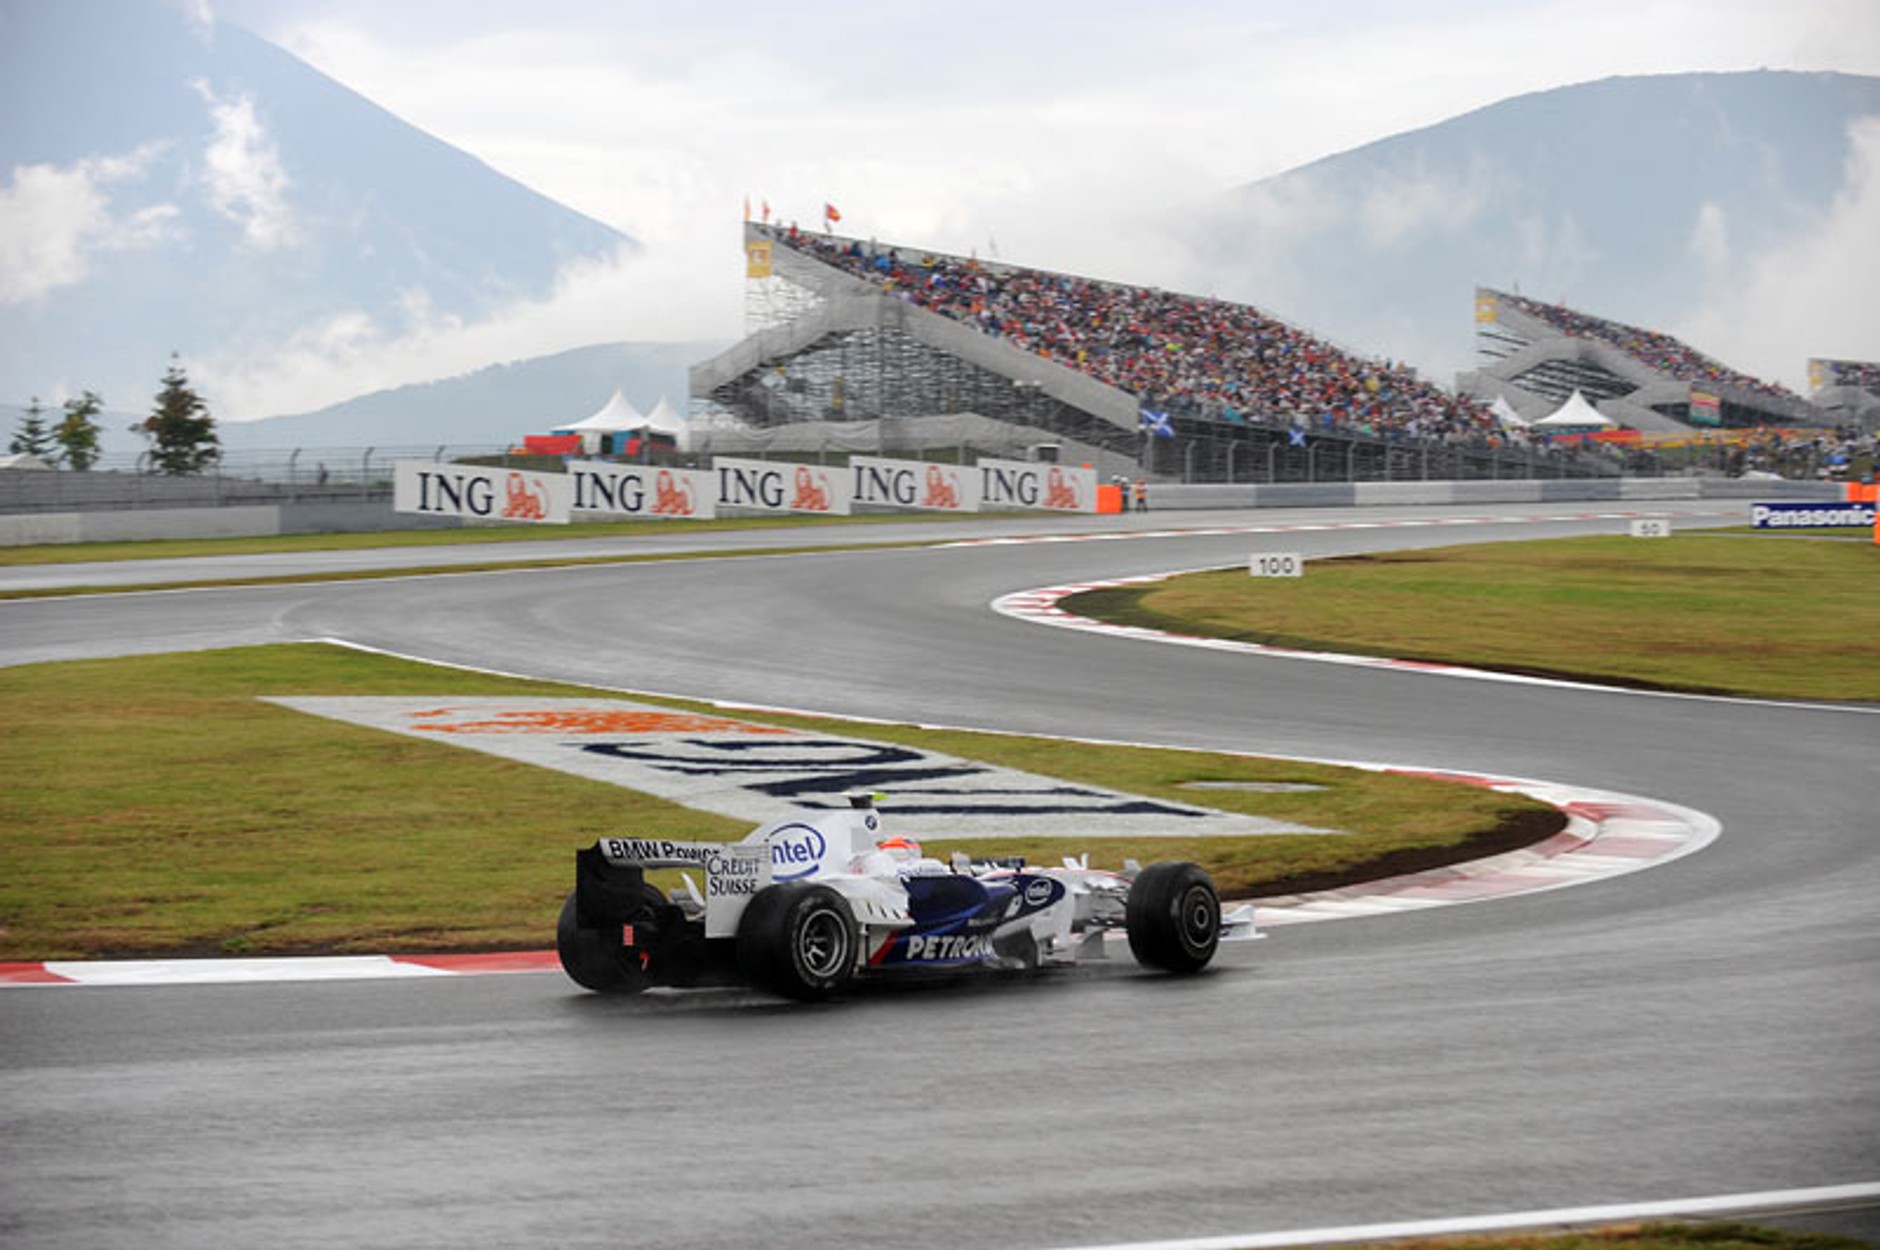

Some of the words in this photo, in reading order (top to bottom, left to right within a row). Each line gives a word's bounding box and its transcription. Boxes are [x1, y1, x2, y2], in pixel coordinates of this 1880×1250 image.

[417, 472, 494, 515] ING
[573, 471, 645, 512] ING
[718, 467, 785, 507] ING
[852, 465, 917, 504] ING
[981, 467, 1039, 506] ING
[1752, 504, 1874, 526] Panasonic
[1259, 556, 1295, 575] 100
[565, 739, 1208, 815] ING
[608, 840, 660, 859] BMW
[707, 855, 759, 875] CREDIT
[763, 836, 815, 864] ntel
[709, 876, 758, 896] SUISSE
